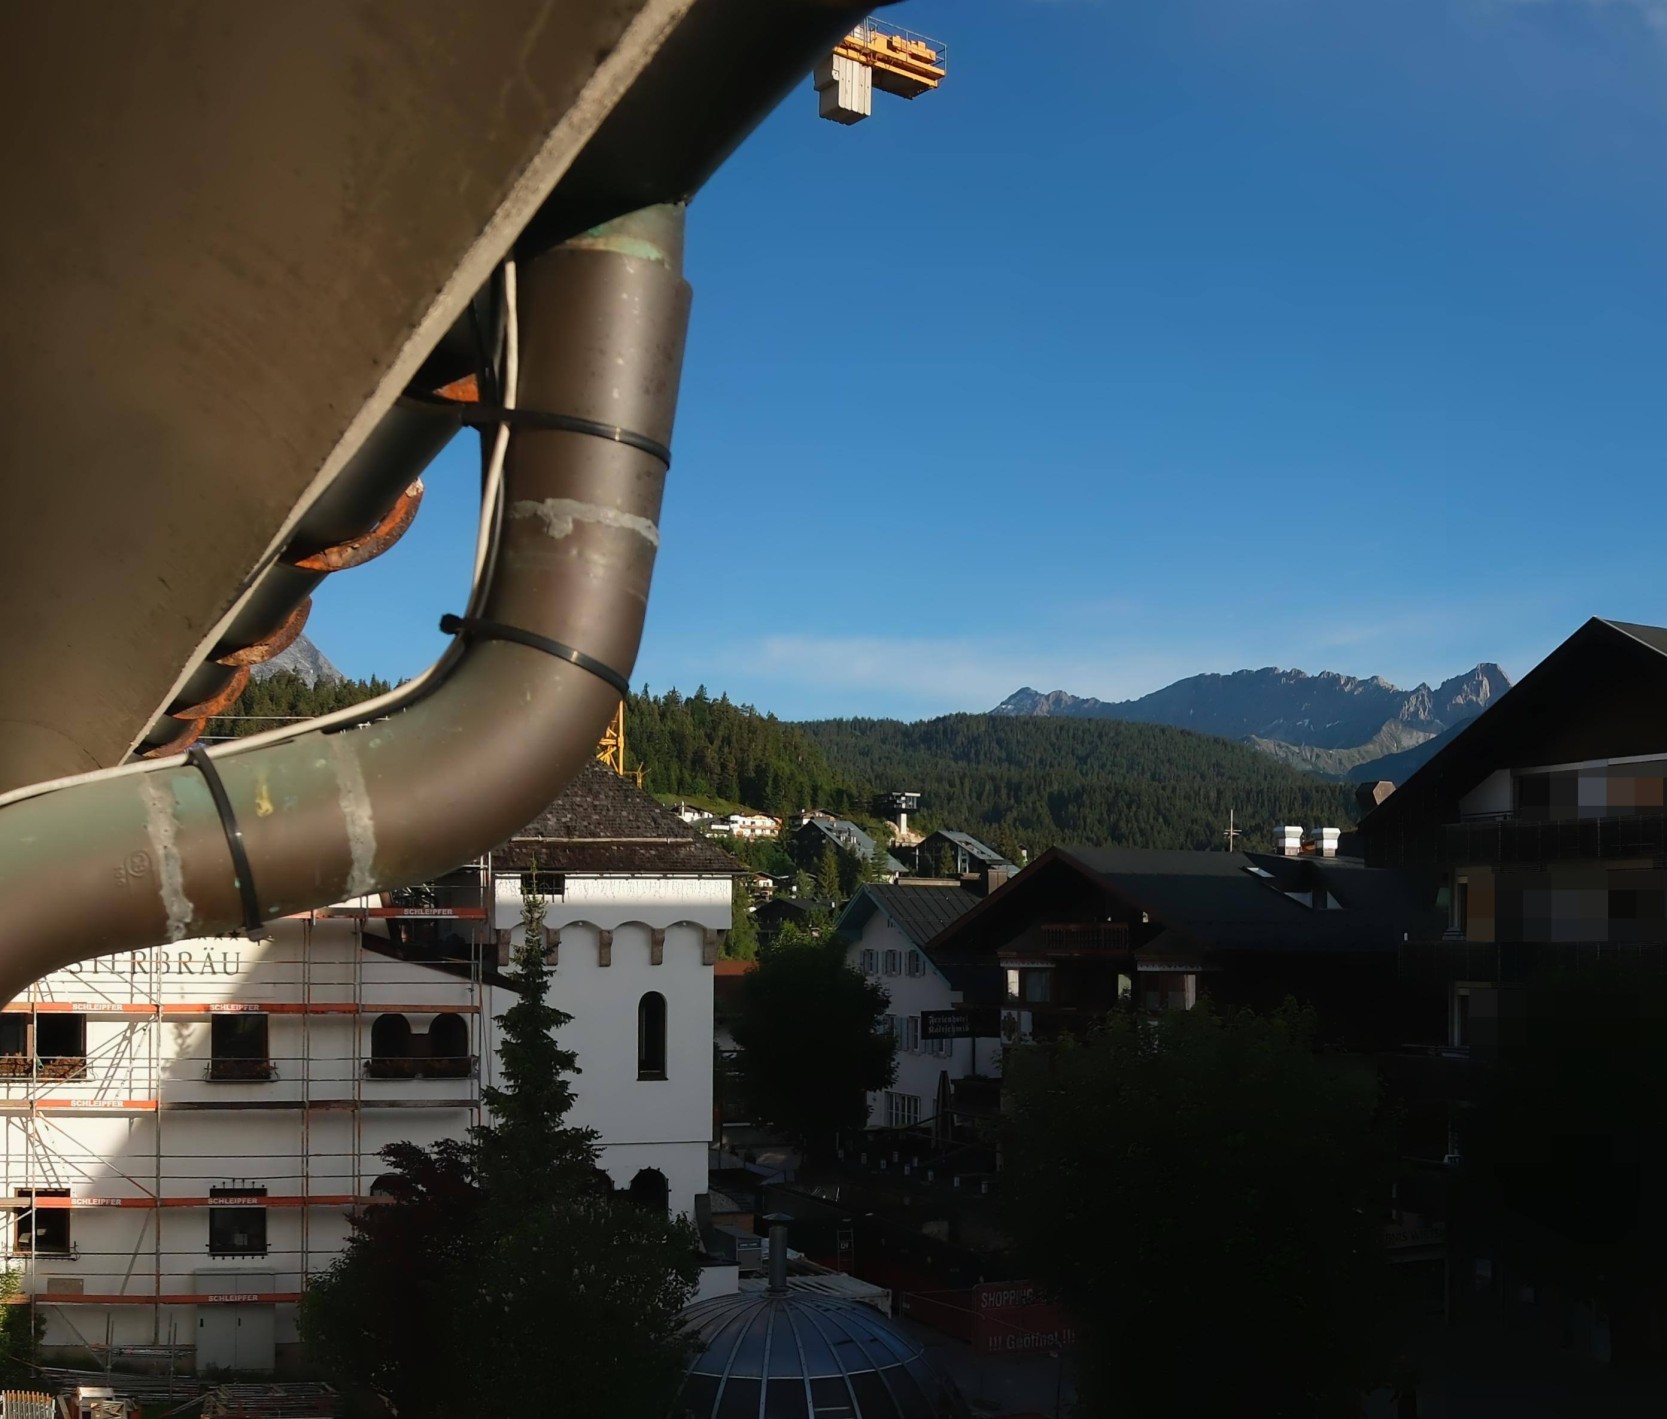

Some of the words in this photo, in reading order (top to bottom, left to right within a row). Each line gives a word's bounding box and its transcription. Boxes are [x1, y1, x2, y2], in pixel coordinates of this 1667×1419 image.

[72, 1003, 123, 1011] SCHLEIPFER
[71, 1198, 122, 1206] SCHLEIPFER
[208, 1197, 258, 1205] SCHLEIPFER
